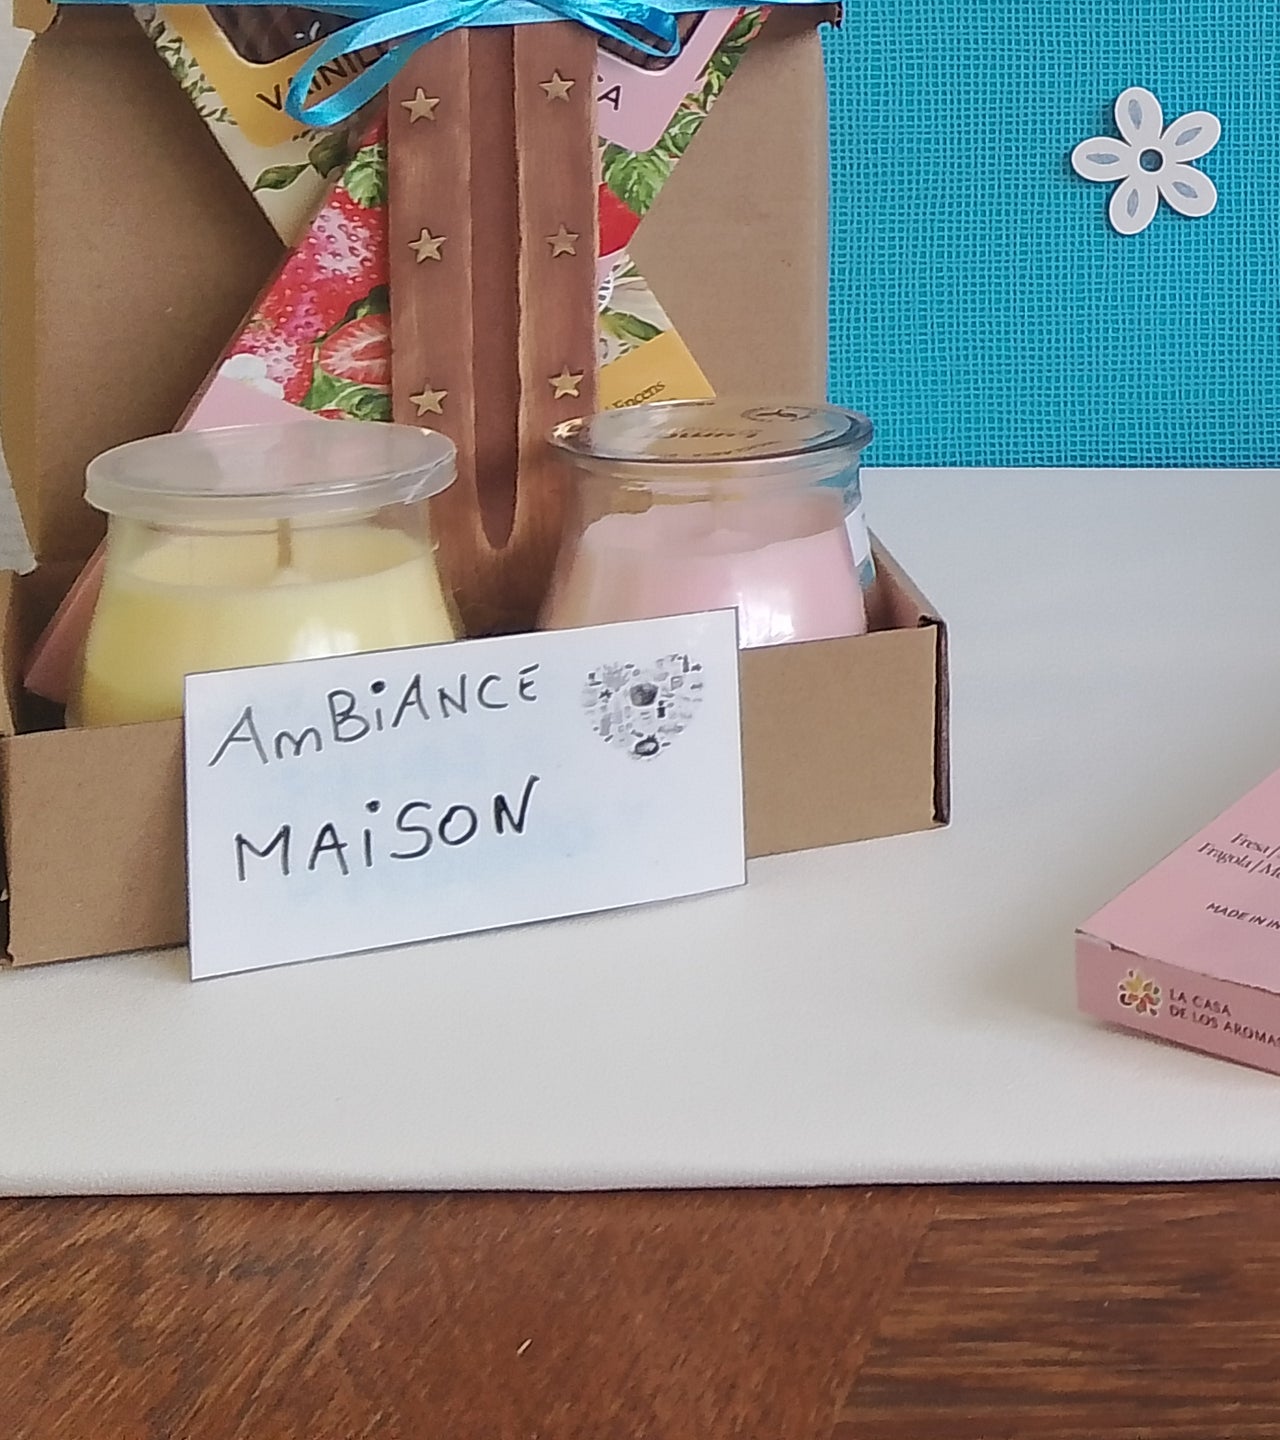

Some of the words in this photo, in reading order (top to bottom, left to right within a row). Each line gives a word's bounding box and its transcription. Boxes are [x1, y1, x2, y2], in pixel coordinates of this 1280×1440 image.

[1198, 842, 1252, 869] Fragola
[1231, 832, 1270, 854] Fresa
[1206, 902, 1250, 921] MADE
[1248, 915, 1267, 926] IN
[1169, 988, 1188, 1004] LA
[1192, 995, 1232, 1017] CASA
[1169, 1004, 1189, 1021] DE
[1192, 1011, 1219, 1030] LOS
